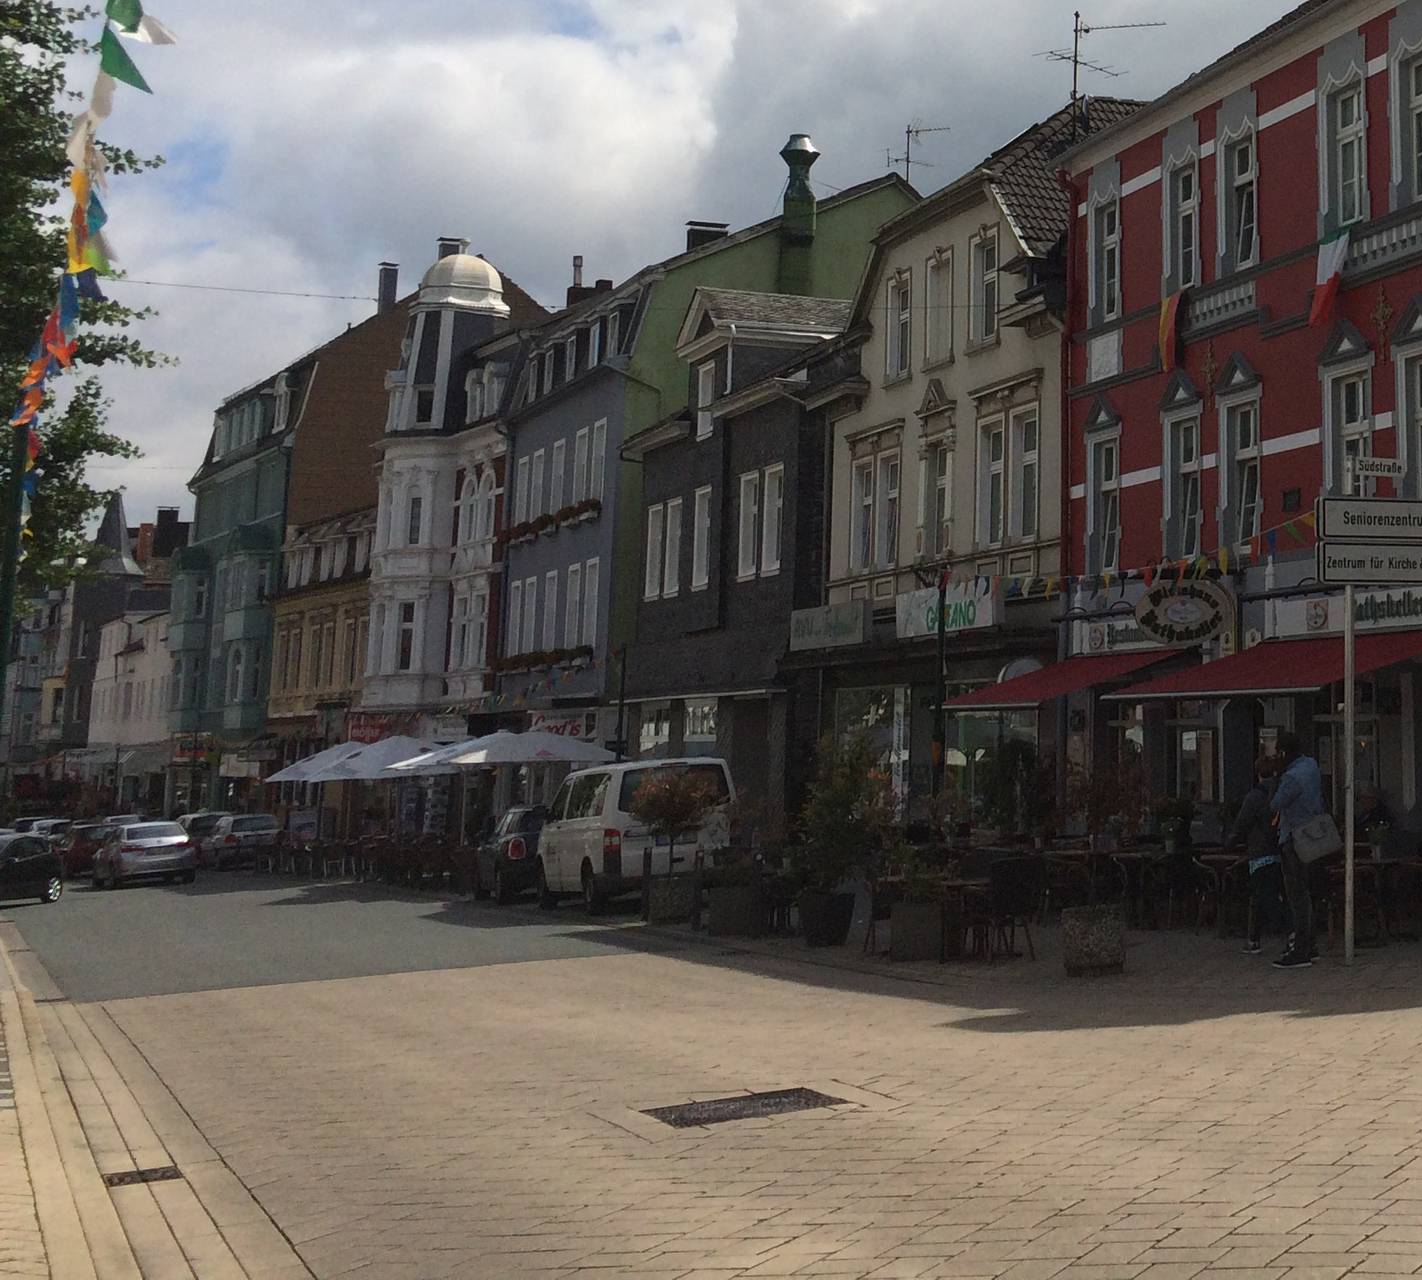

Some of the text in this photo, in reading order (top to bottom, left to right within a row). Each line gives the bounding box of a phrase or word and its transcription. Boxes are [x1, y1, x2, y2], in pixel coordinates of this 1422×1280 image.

[1359, 459, 1403, 474] Südstraße
[1326, 556, 1366, 569] Zentrum
[1370, 556, 1385, 569] für
[1388, 557, 1418, 570] Kirche
[926, 600, 977, 633] GATANO
